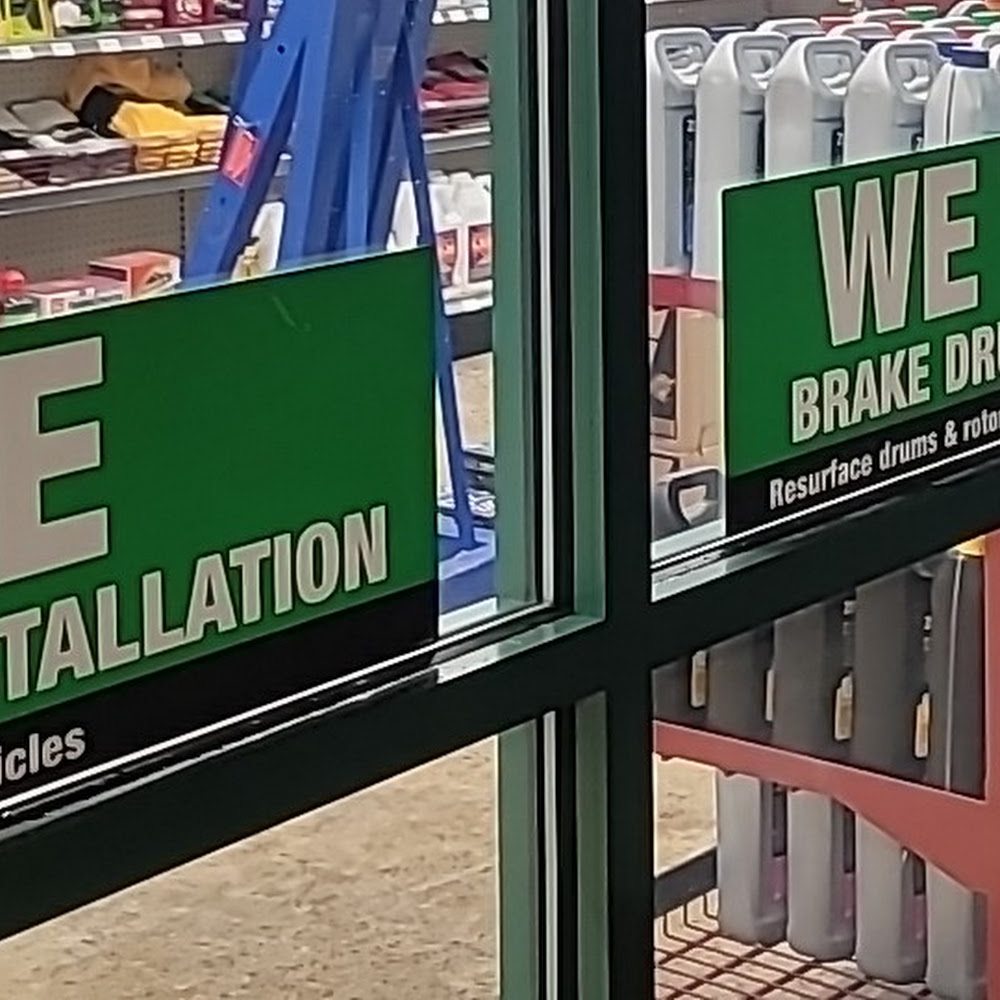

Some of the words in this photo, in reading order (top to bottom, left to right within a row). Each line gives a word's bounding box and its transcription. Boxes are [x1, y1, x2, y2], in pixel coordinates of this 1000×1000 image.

[815, 159, 978, 346] WE
[0, 335, 109, 585] E
[769, 453, 873, 509] Resurface
[879, 431, 938, 470] drums
[944, 421, 958, 448] &
[792, 343, 930, 444] BRAKE
[0, 506, 388, 702] TALLATION
